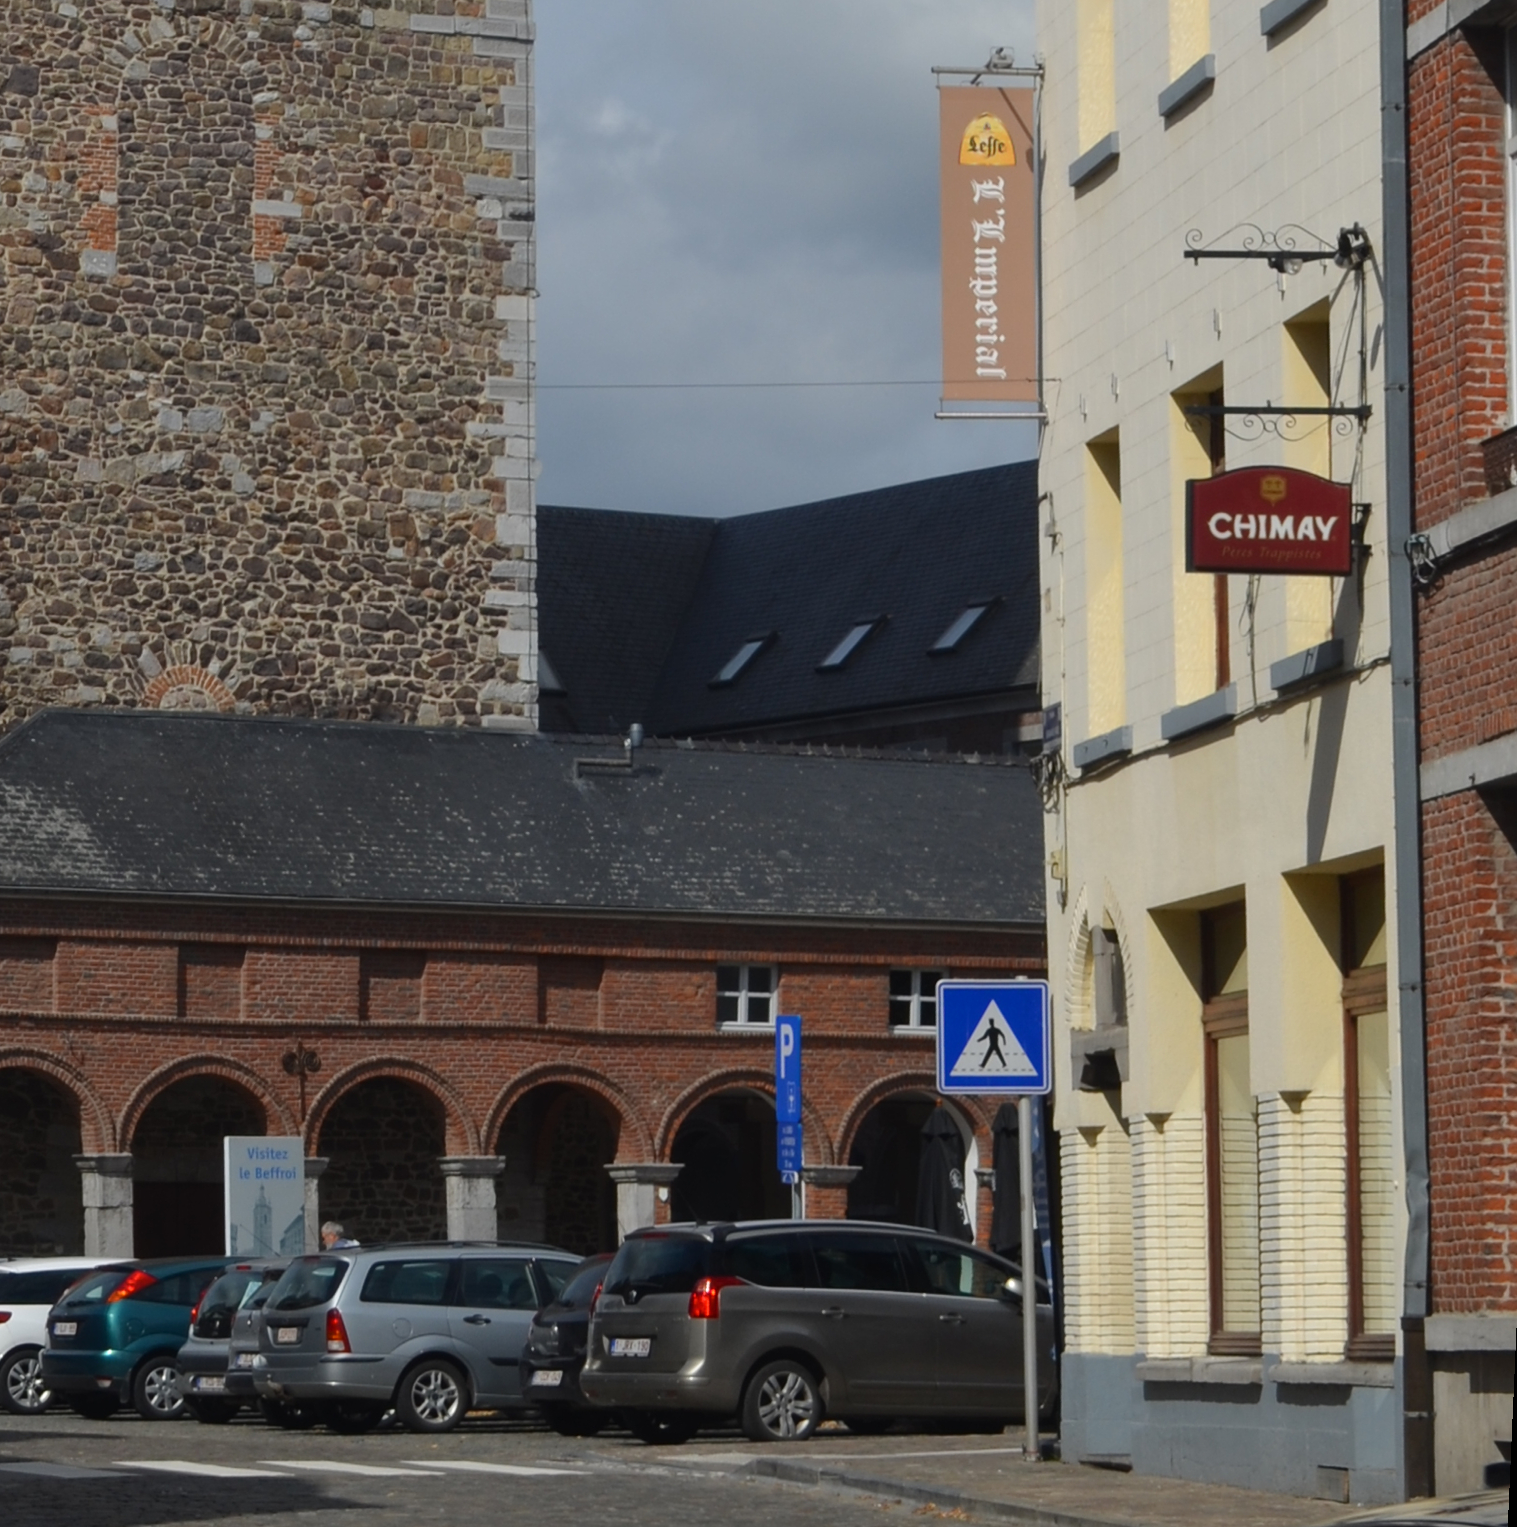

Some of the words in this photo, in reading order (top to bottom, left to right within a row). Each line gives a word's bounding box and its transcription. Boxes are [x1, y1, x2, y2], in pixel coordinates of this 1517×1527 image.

[967, 134, 1006, 158] Leffe
[1207, 511, 1339, 542] CHIMAY
[1259, 546, 1322, 562] Trappistes
[780, 1023, 794, 1079] P
[247, 1147, 289, 1160] Visitez
[239, 1167, 251, 1179] le
[255, 1166, 297, 1180] Beffroi
